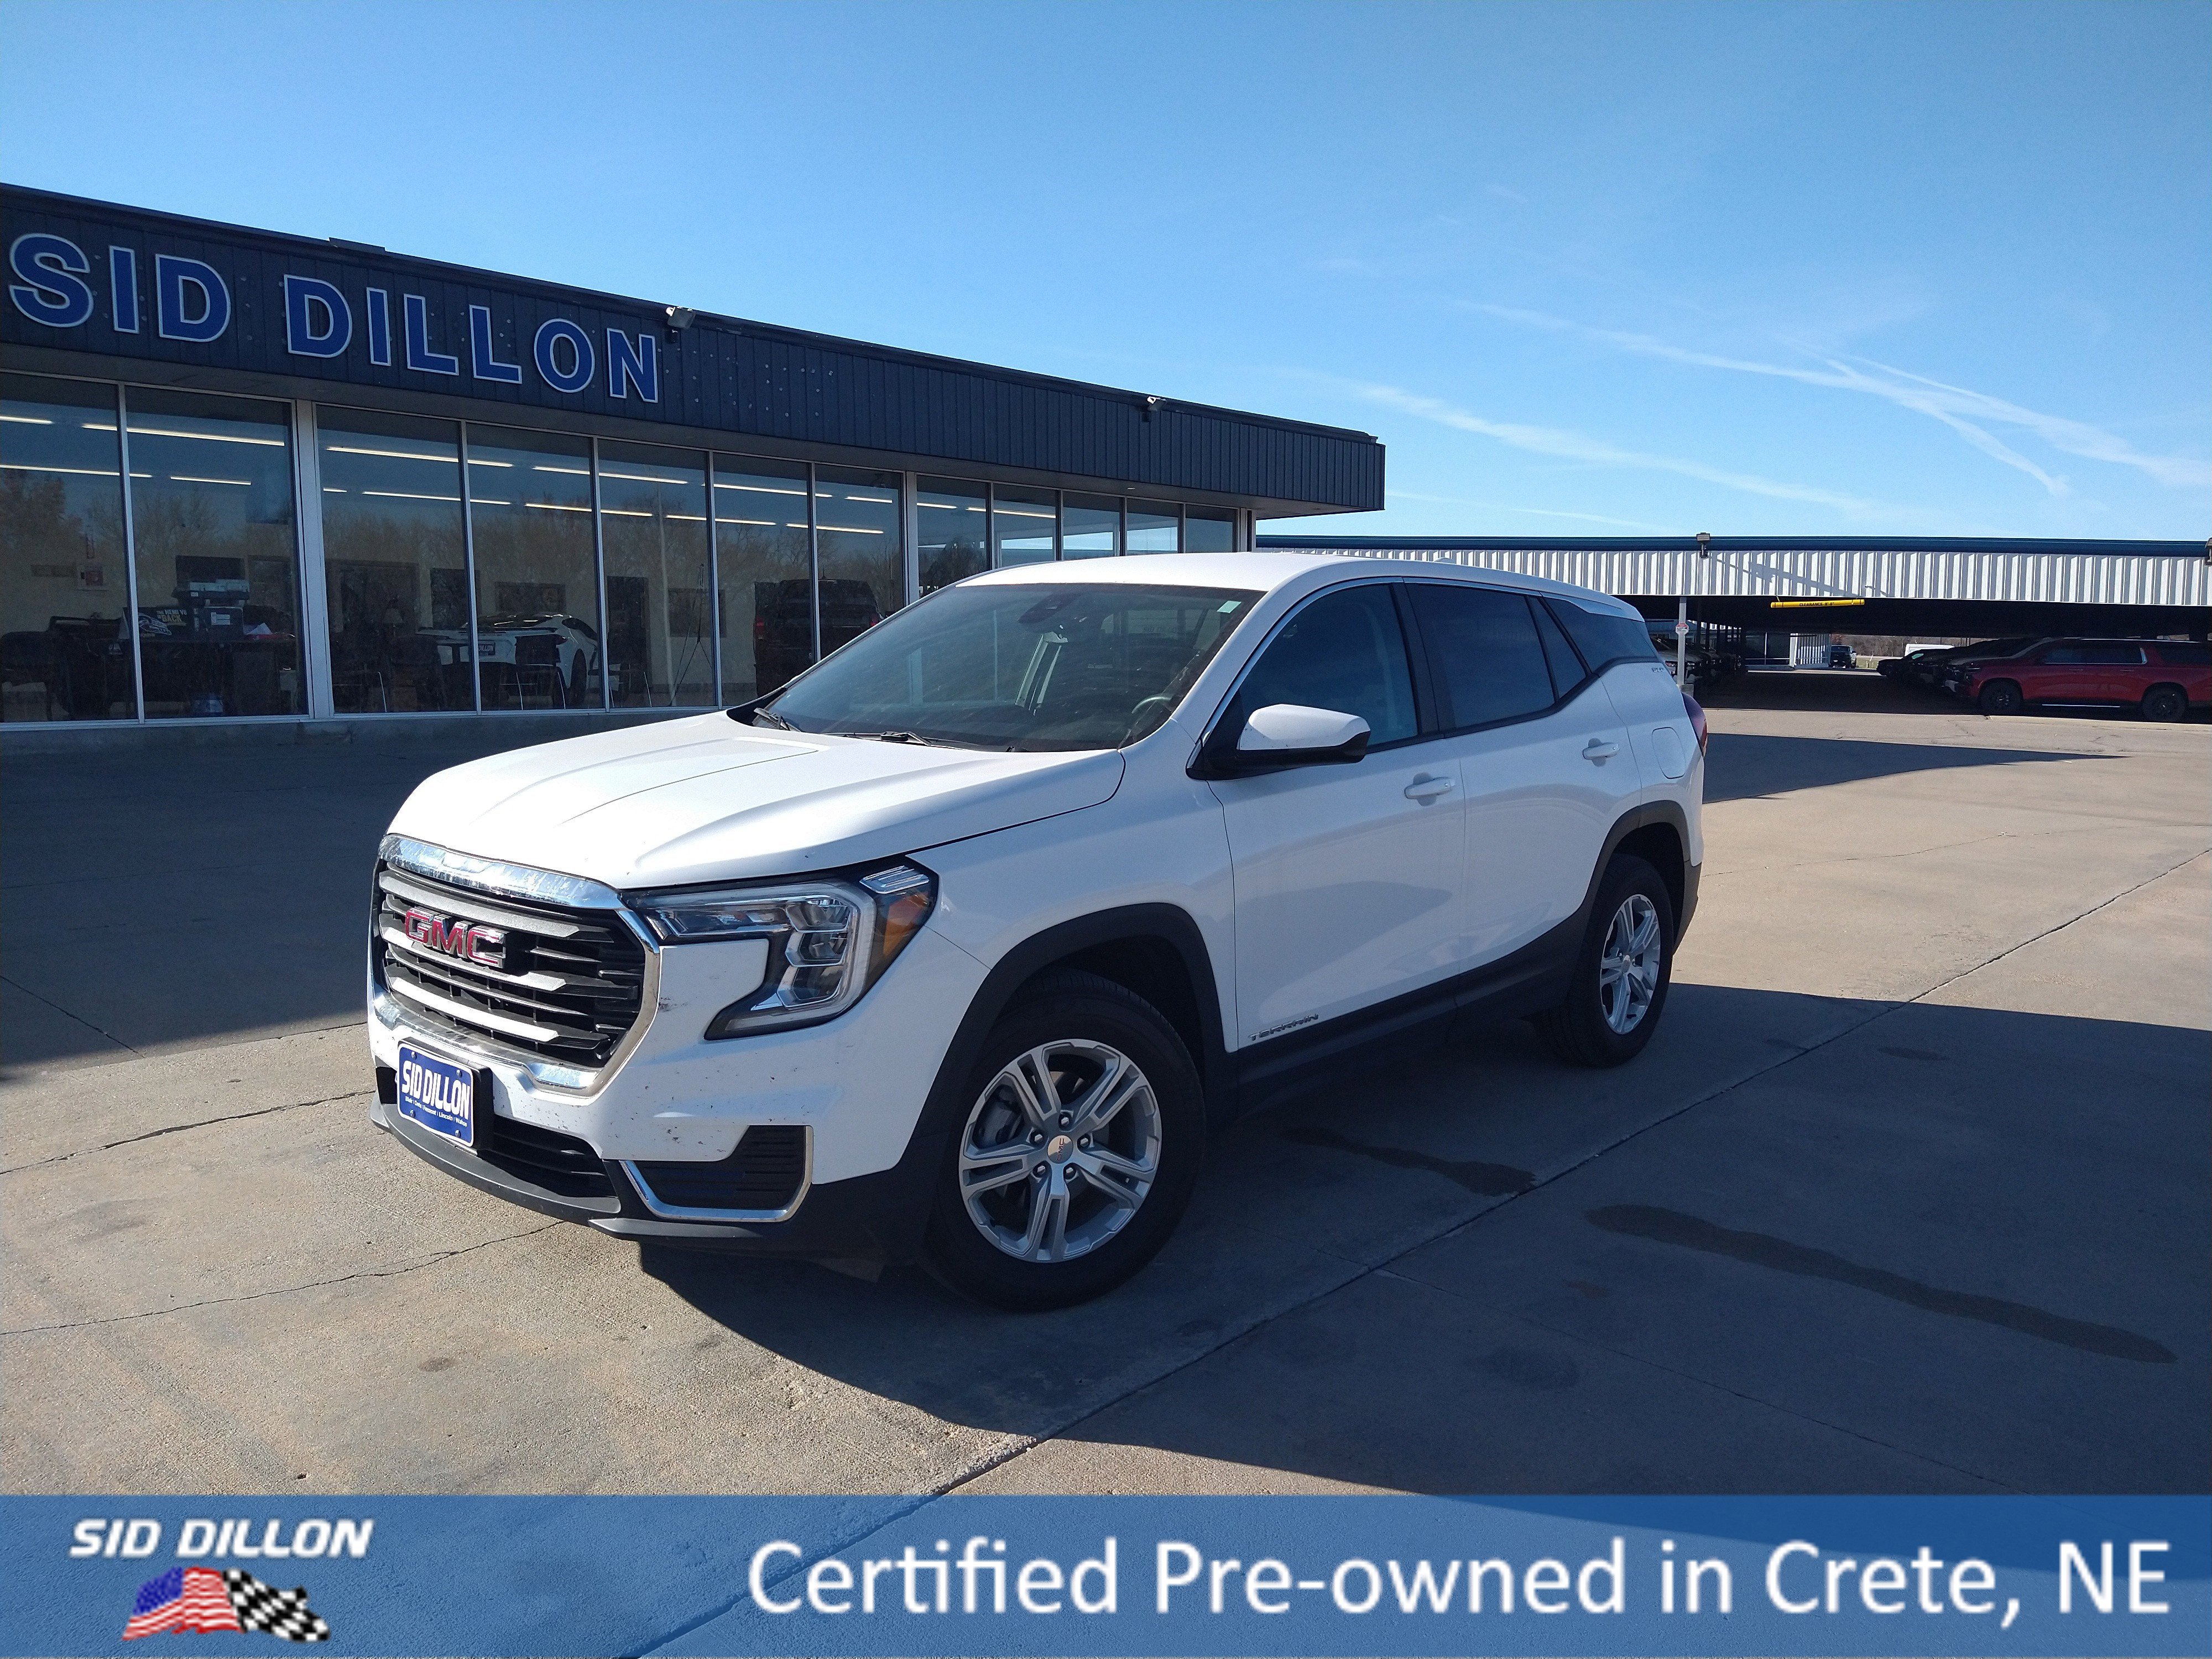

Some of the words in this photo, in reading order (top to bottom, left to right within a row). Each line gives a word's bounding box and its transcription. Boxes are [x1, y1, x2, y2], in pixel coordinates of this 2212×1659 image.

[8, 232, 231, 343] SID
[284, 274, 659, 404] DILLON
[405, 907, 507, 969] GMC
[1248, 1013, 1319, 1041] TERRAIN
[401, 1060, 422, 1099] SID
[422, 1068, 471, 1120] DILLON
